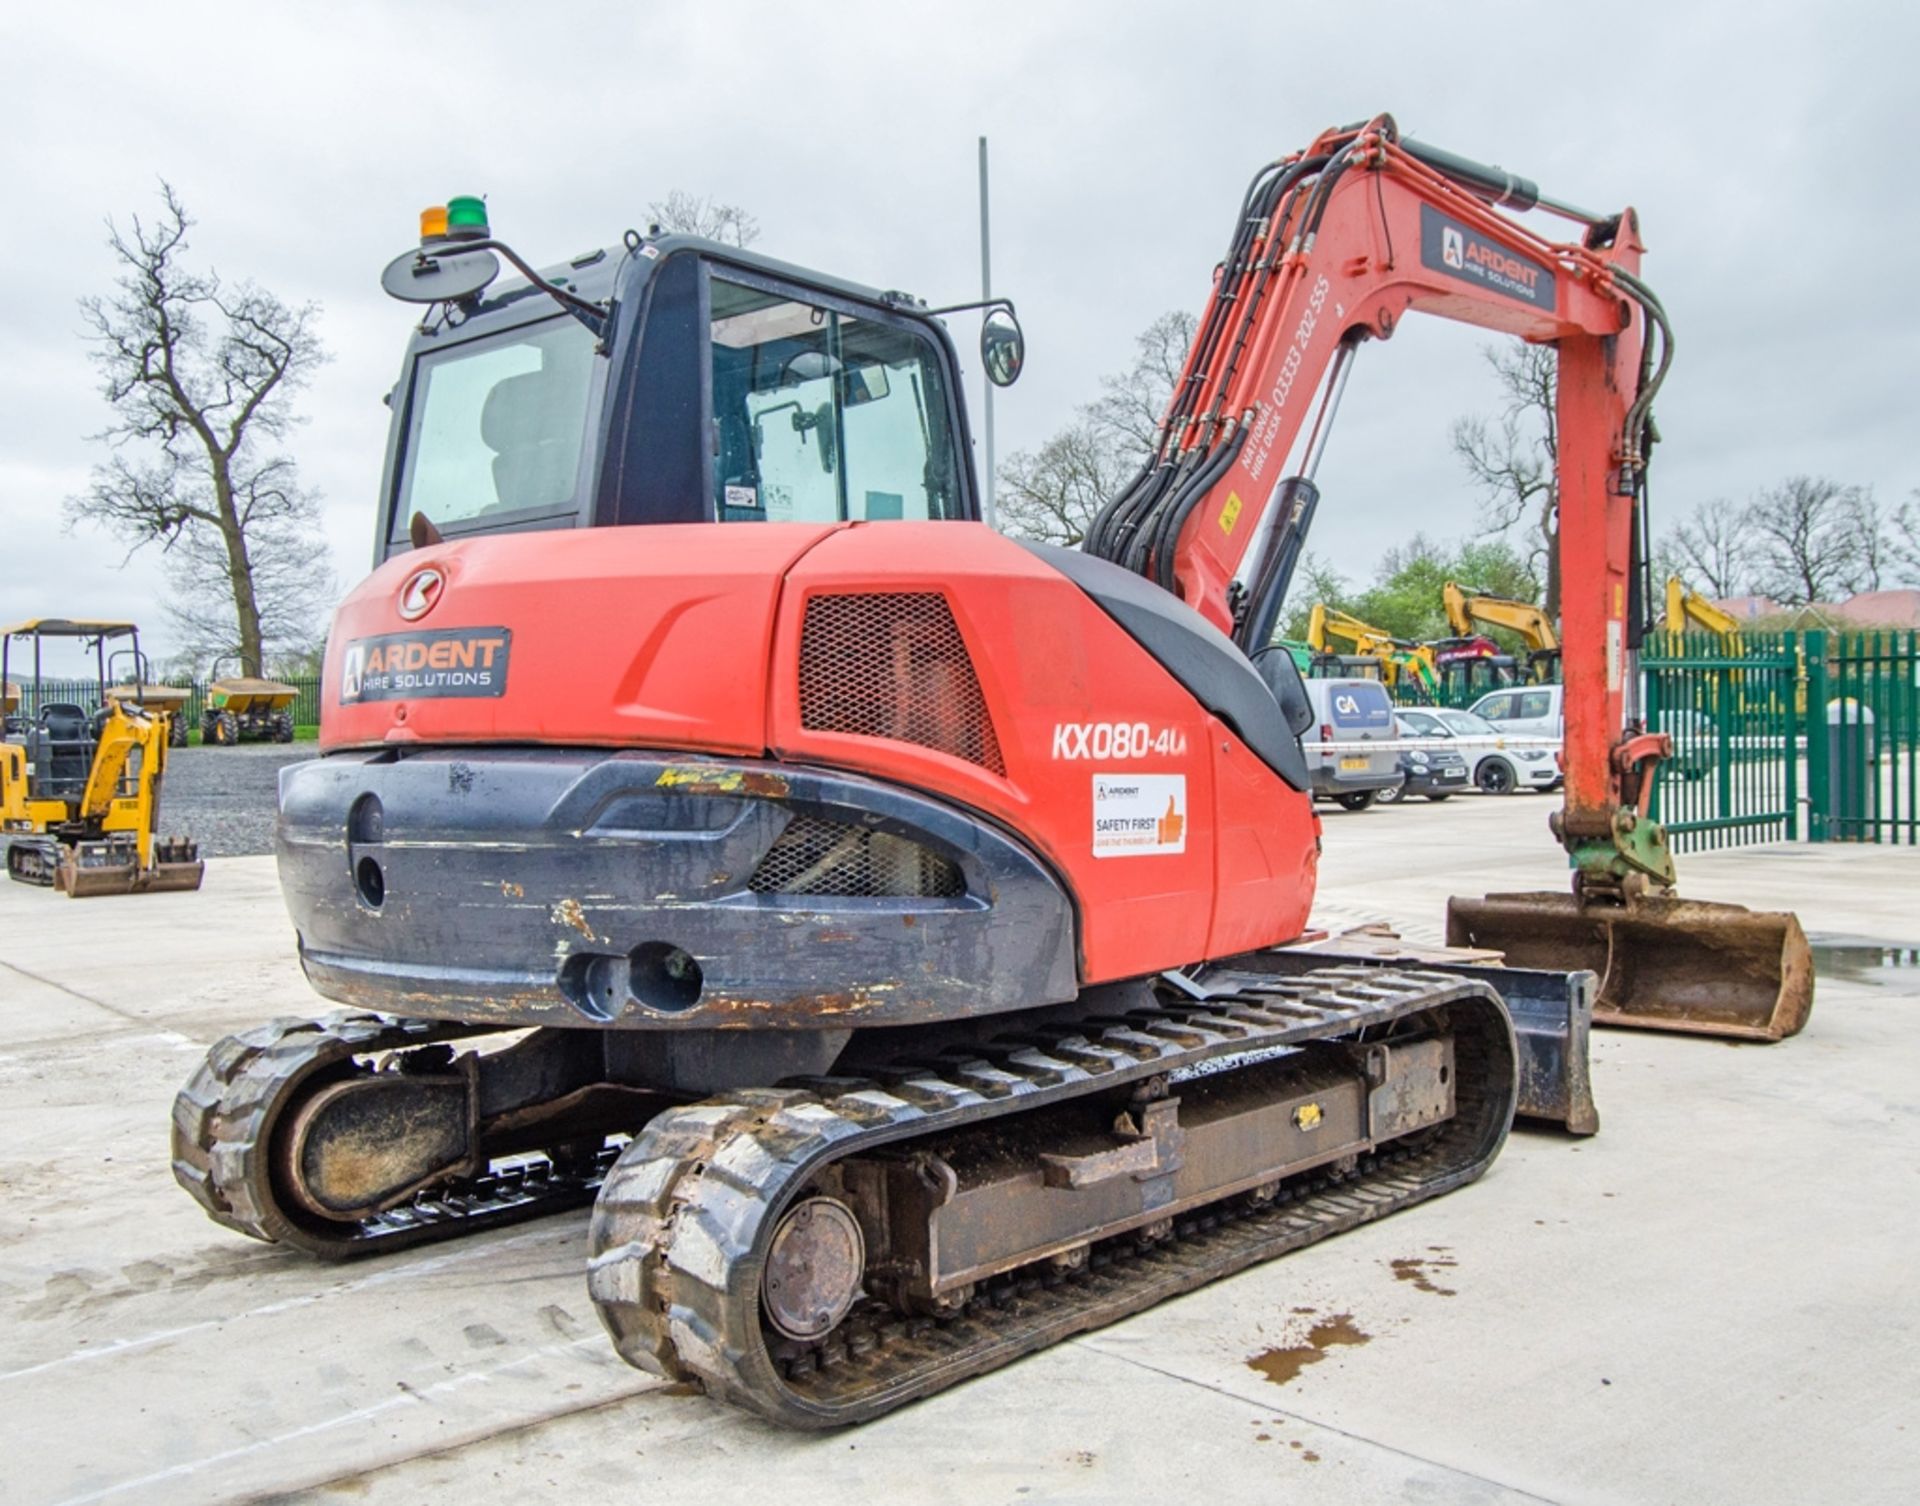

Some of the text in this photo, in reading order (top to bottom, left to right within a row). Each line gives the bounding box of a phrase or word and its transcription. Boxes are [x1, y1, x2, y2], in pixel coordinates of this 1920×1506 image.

[1464, 261, 1536, 299] HIRE SOLUTIONS
[1466, 242, 1538, 287] ARDENT
[1272, 273, 1330, 407] 03333 202 555
[1242, 403, 1273, 469] NATIONAL
[1249, 414, 1283, 481] HIRE DESK
[366, 639, 503, 673] ARDENT
[363, 671, 492, 691] HIRE SOLUTIONS
[1109, 787, 1139, 795] ARDENT
[1096, 816, 1156, 832] SAFETY FIRST
